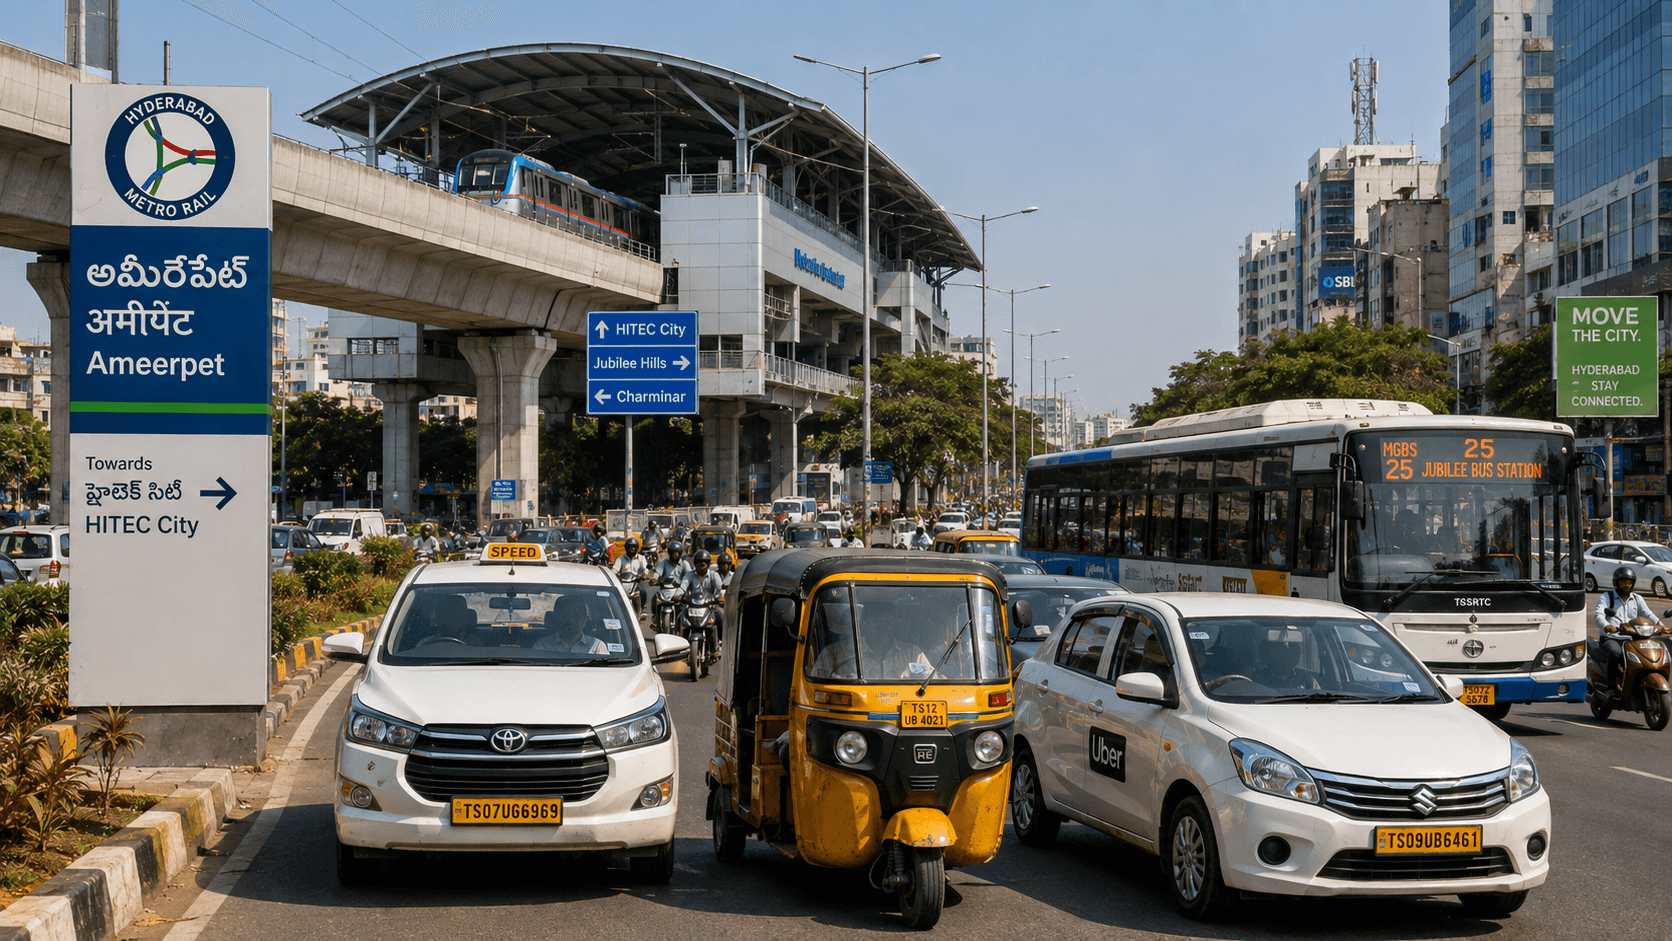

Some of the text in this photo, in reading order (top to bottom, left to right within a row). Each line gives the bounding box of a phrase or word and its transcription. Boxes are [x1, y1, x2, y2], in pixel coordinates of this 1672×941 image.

[125, 97, 215, 125] HYDERABAD
[124, 187, 216, 217] METRO RAIL
[86, 253, 250, 288] అమీరేపేట్
[1572, 307, 1639, 325] MOVE
[616, 323, 686, 338] HITEC City
[1572, 329, 1642, 342] THE CITY.
[86, 350, 225, 382] Ameerpet
[593, 357, 667, 369] Jubilee Hills
[1572, 365, 1640, 375] HYDERABAD
[1591, 380, 1619, 391] STAY
[617, 390, 686, 403] Charminar
[1571, 396, 1643, 406] CONNECTED.
[1383, 438, 1495, 459] MGBS 25
[85, 456, 152, 470] Towards
[1385, 459, 1542, 480] 25 JUBILEE BUS STATION
[148, 479, 183, 500] సిటీ
[86, 515, 199, 538] HITEC City
[491, 546, 536, 557] SPEED
[1454, 597, 1491, 607] TSSRTC
[911, 703, 937, 713] TS12
[905, 715, 944, 725] UB 4021
[1092, 734, 1123, 769] Uber
[463, 803, 558, 819] TS07UG6969
[1387, 831, 1478, 849] TS09UB6461
